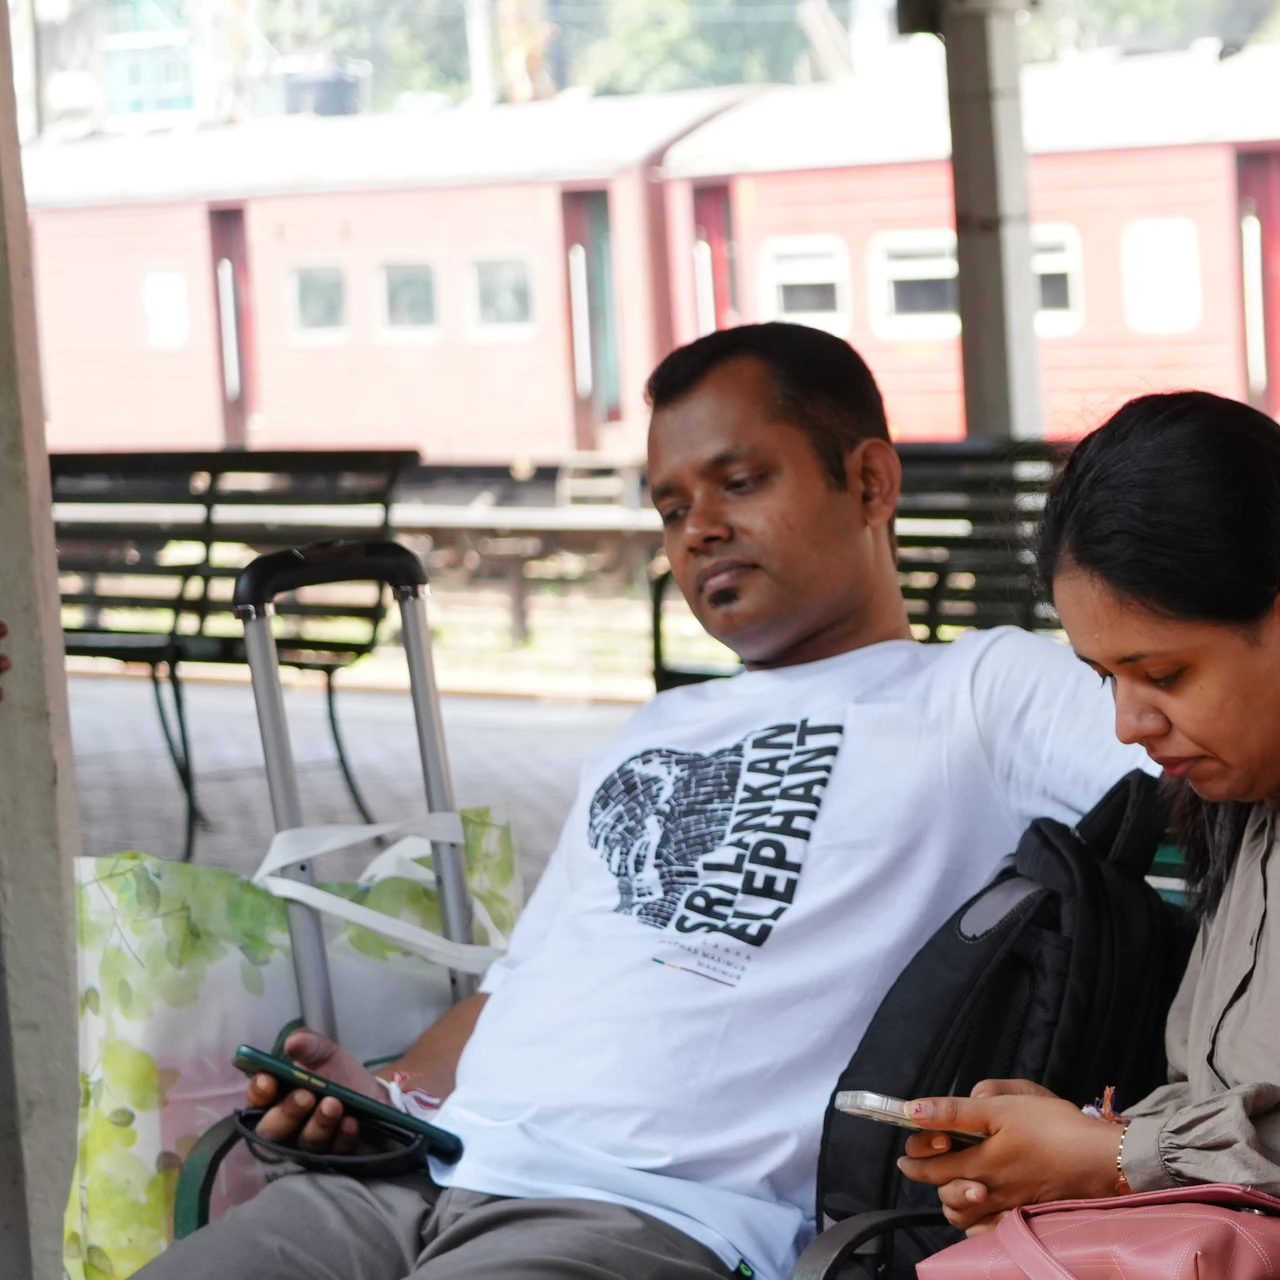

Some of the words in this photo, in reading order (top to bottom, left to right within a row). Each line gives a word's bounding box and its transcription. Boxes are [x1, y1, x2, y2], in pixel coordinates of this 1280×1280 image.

[702, 723, 798, 874] LANKAN
[719, 716, 844, 948] ELEPHANT
[675, 882, 741, 935] SRI
